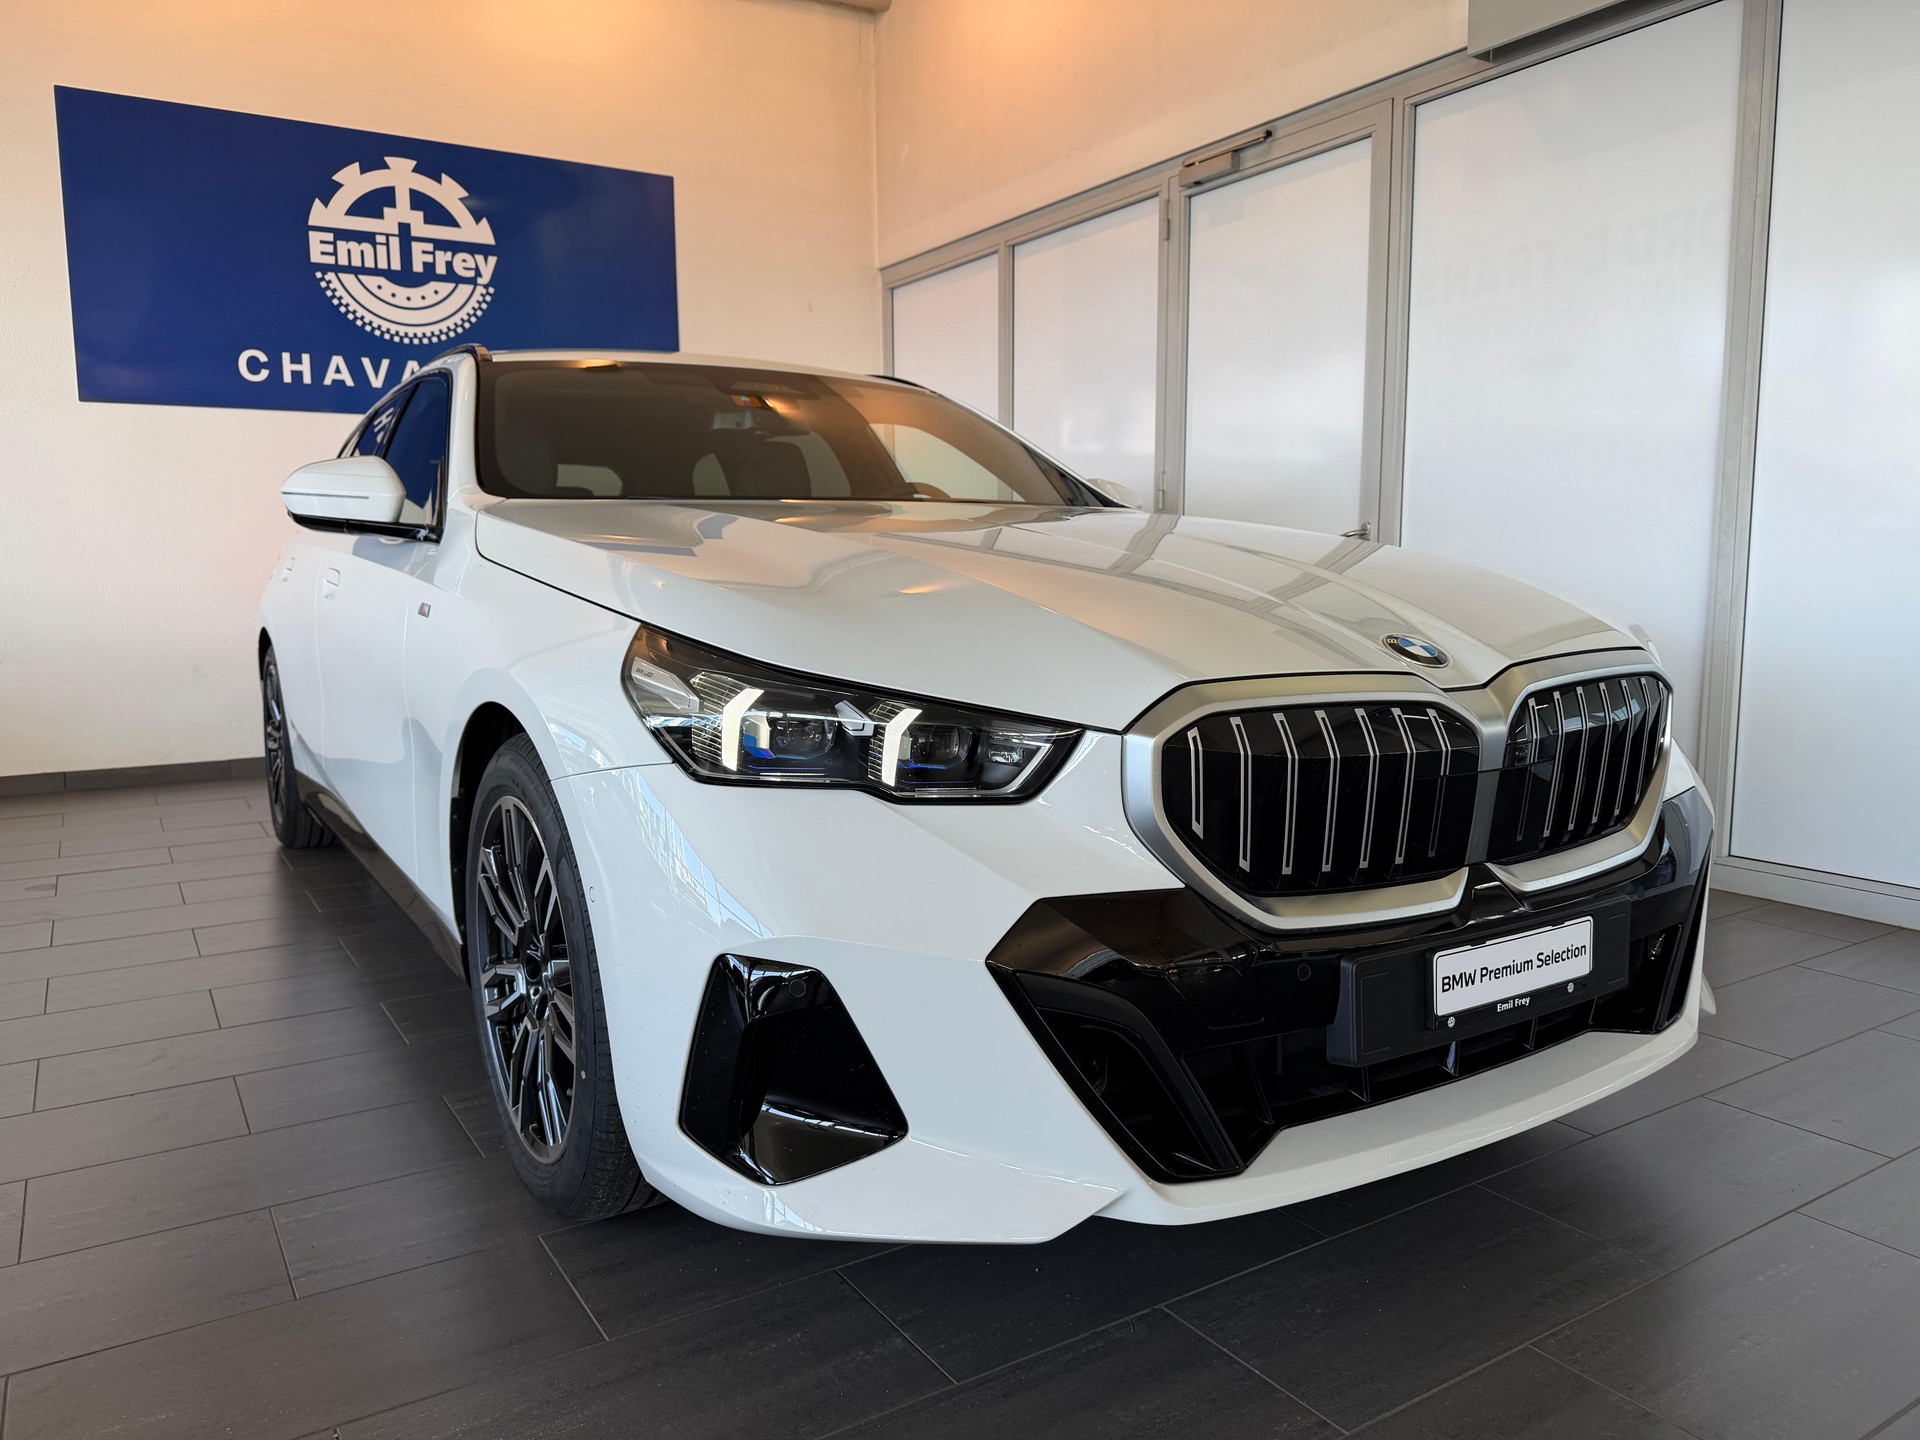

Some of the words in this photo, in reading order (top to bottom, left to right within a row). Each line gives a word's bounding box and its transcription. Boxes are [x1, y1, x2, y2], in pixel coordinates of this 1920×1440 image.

[308, 230, 402, 271] Emil
[411, 241, 498, 286] Frey
[1441, 968, 1478, 993] BMW
[1479, 958, 1534, 984] Premium
[1536, 944, 1587, 969] Selection
[1496, 998, 1514, 1013] Emil
[1514, 996, 1531, 1008] Frey
